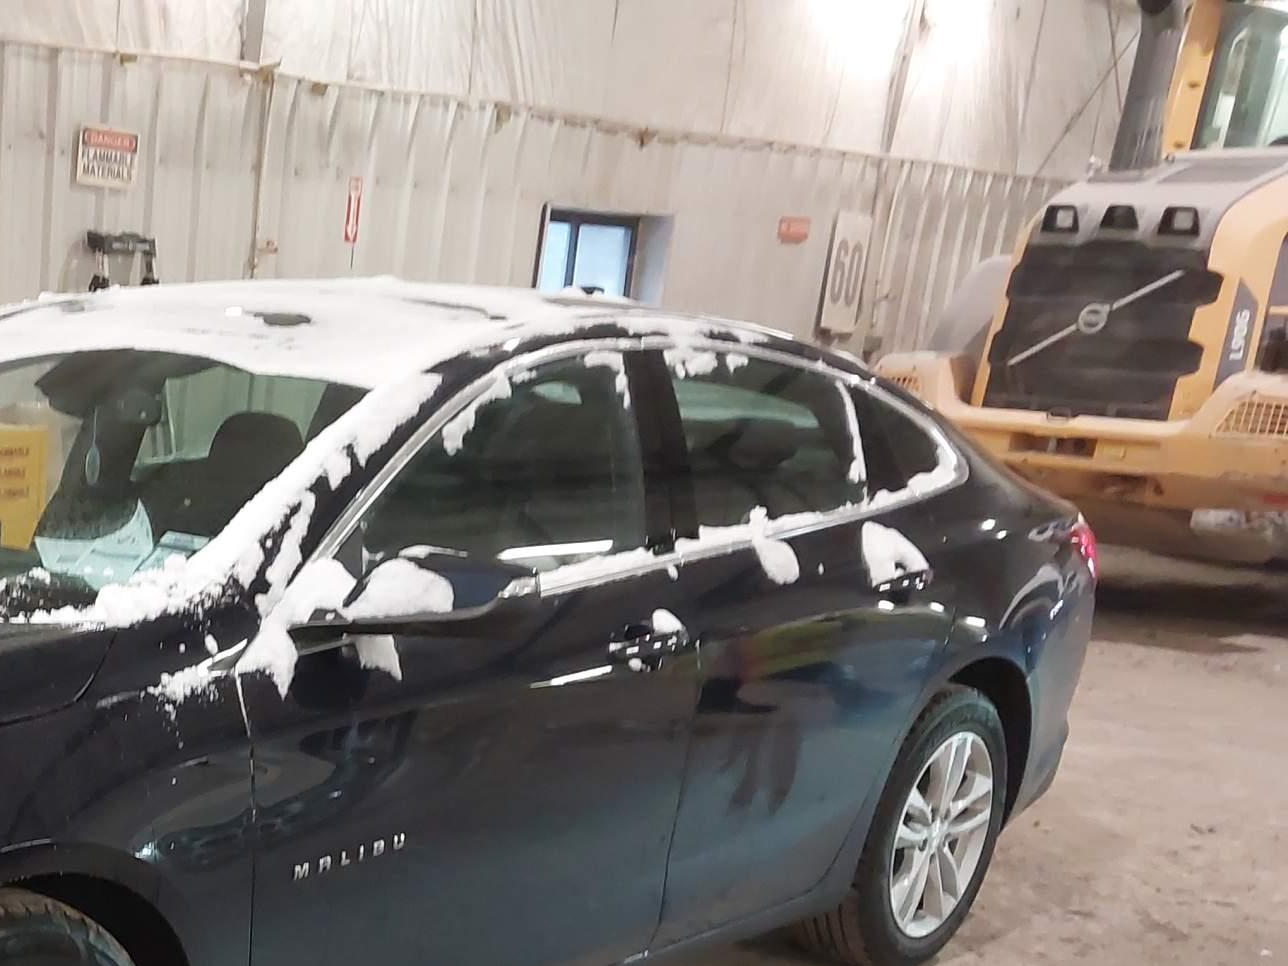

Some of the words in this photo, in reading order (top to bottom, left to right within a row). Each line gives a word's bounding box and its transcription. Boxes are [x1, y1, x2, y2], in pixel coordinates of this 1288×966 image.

[89, 131, 131, 149] DANGER
[829, 237, 863, 307] 60
[293, 832, 405, 881] MALIBU
